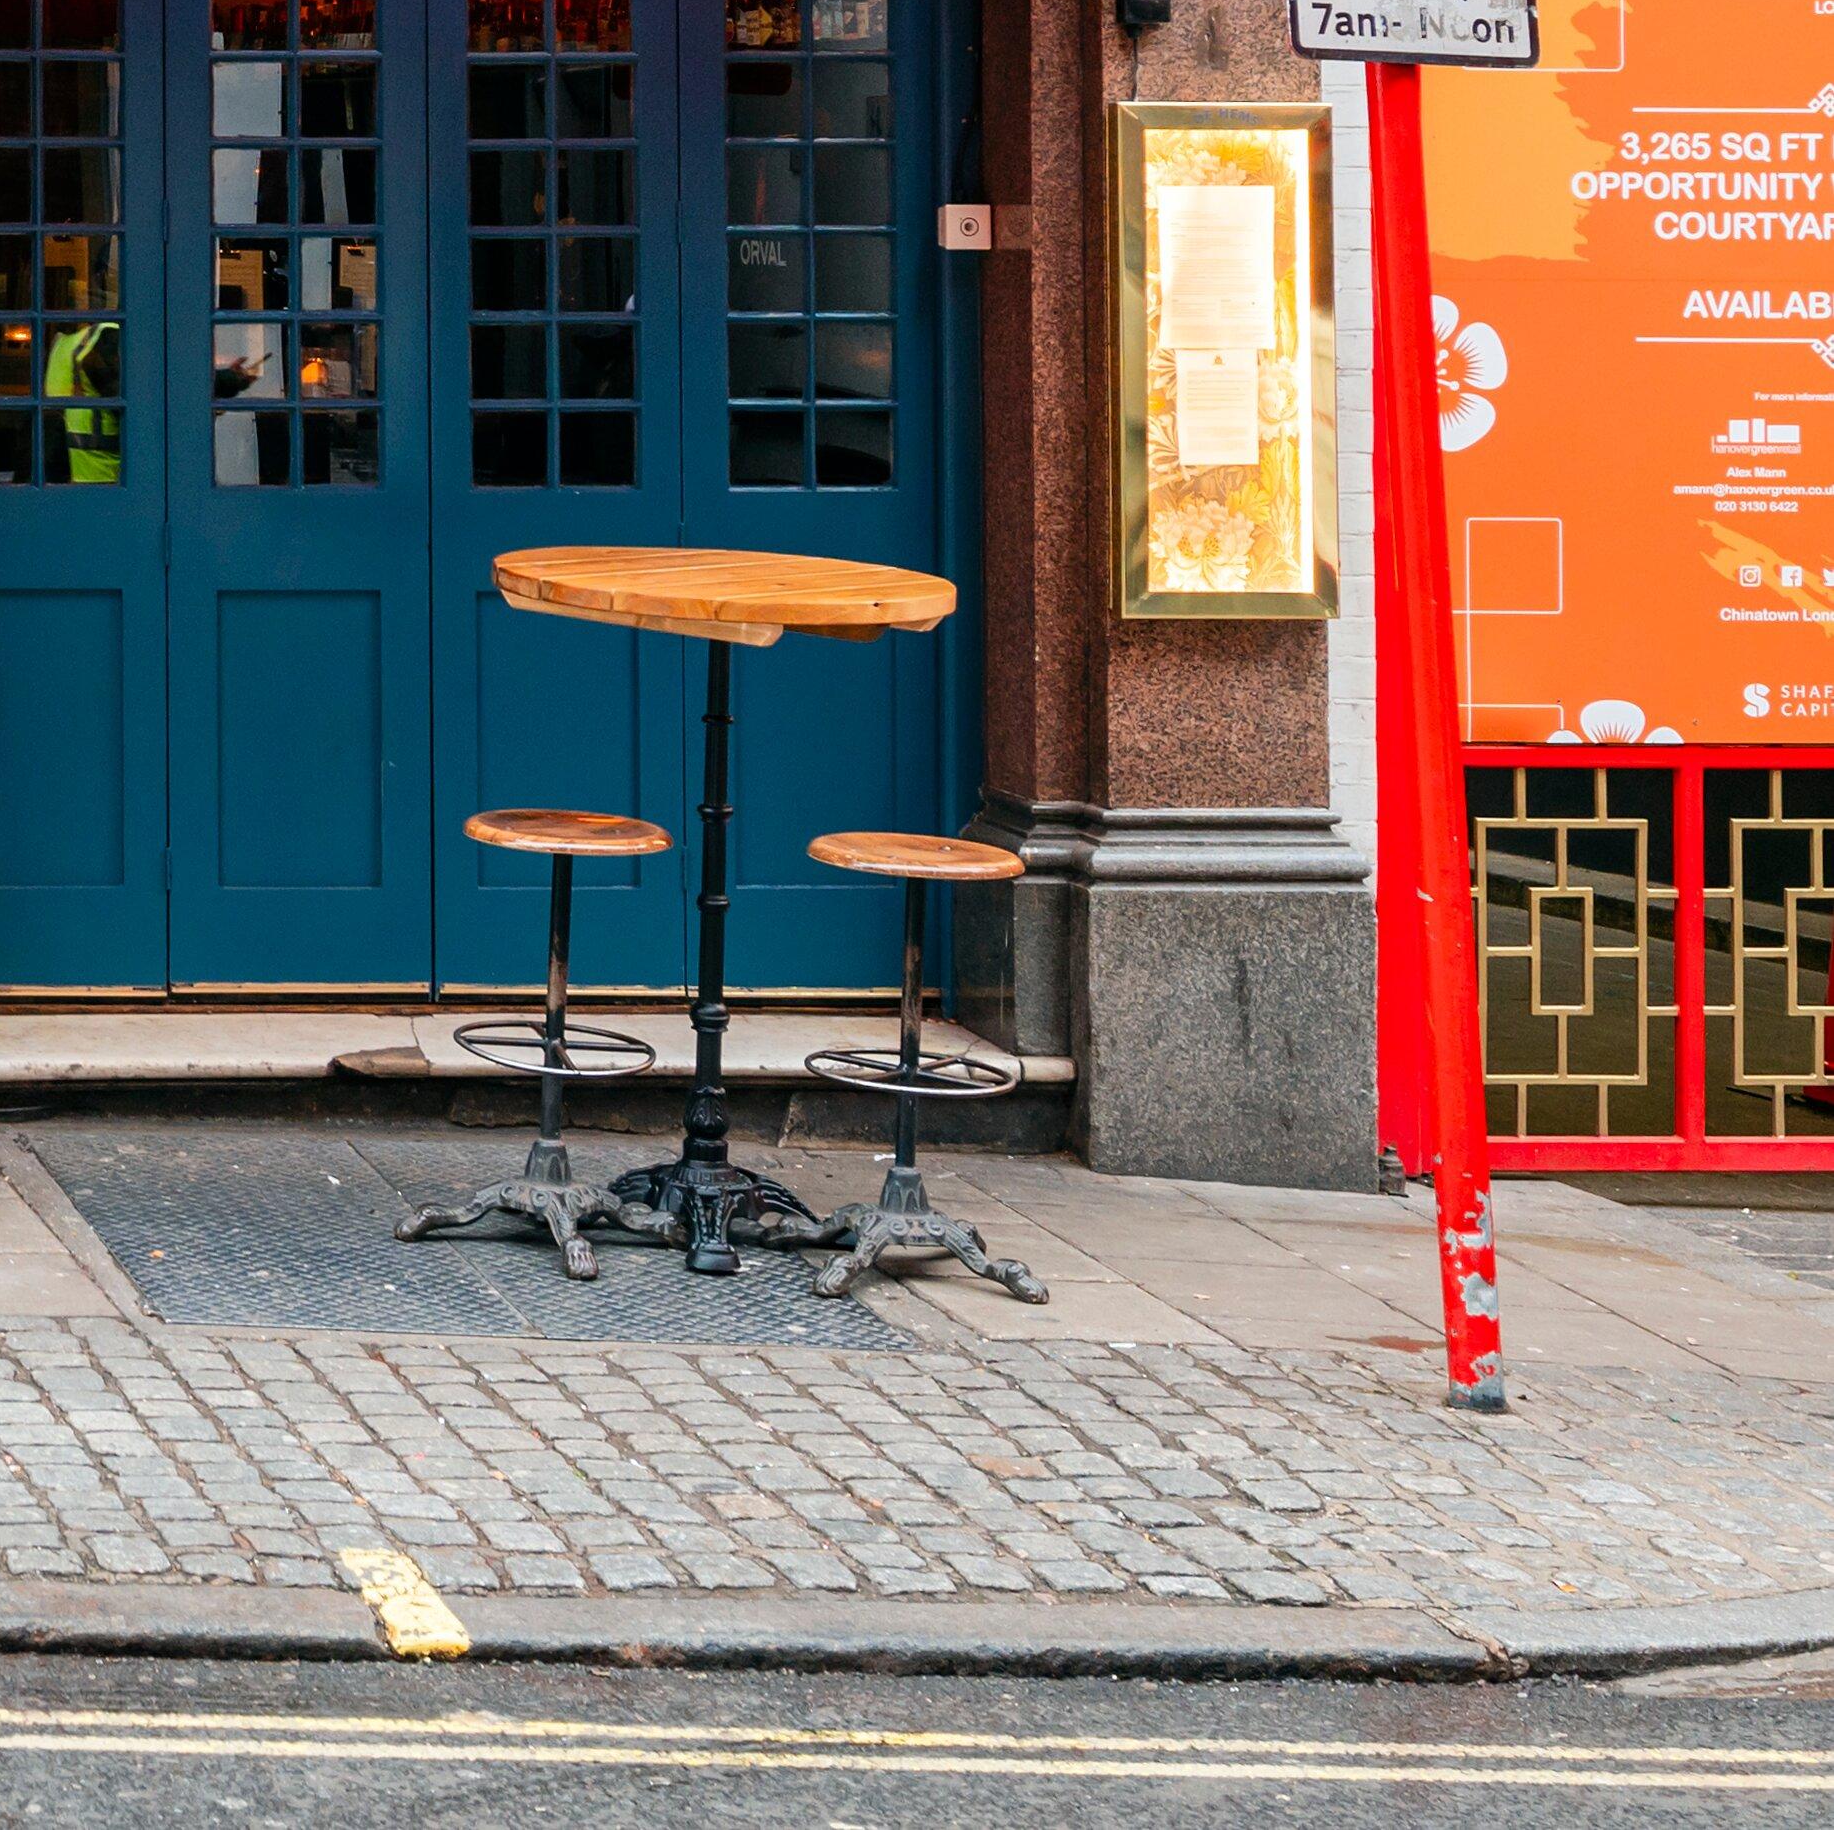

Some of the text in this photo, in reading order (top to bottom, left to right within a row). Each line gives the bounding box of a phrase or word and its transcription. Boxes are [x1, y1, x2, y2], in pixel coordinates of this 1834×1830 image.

[1620, 132, 1823, 165] 3,265 SQ FT
[1570, 171, 1823, 201] OPPORTUNITY
[739, 239, 787, 267] ORVAL
[1726, 467, 1786, 478] Alex Mann
[1715, 501, 1798, 512] 020 3130 6422
[1719, 607, 1799, 621] Chinatown
